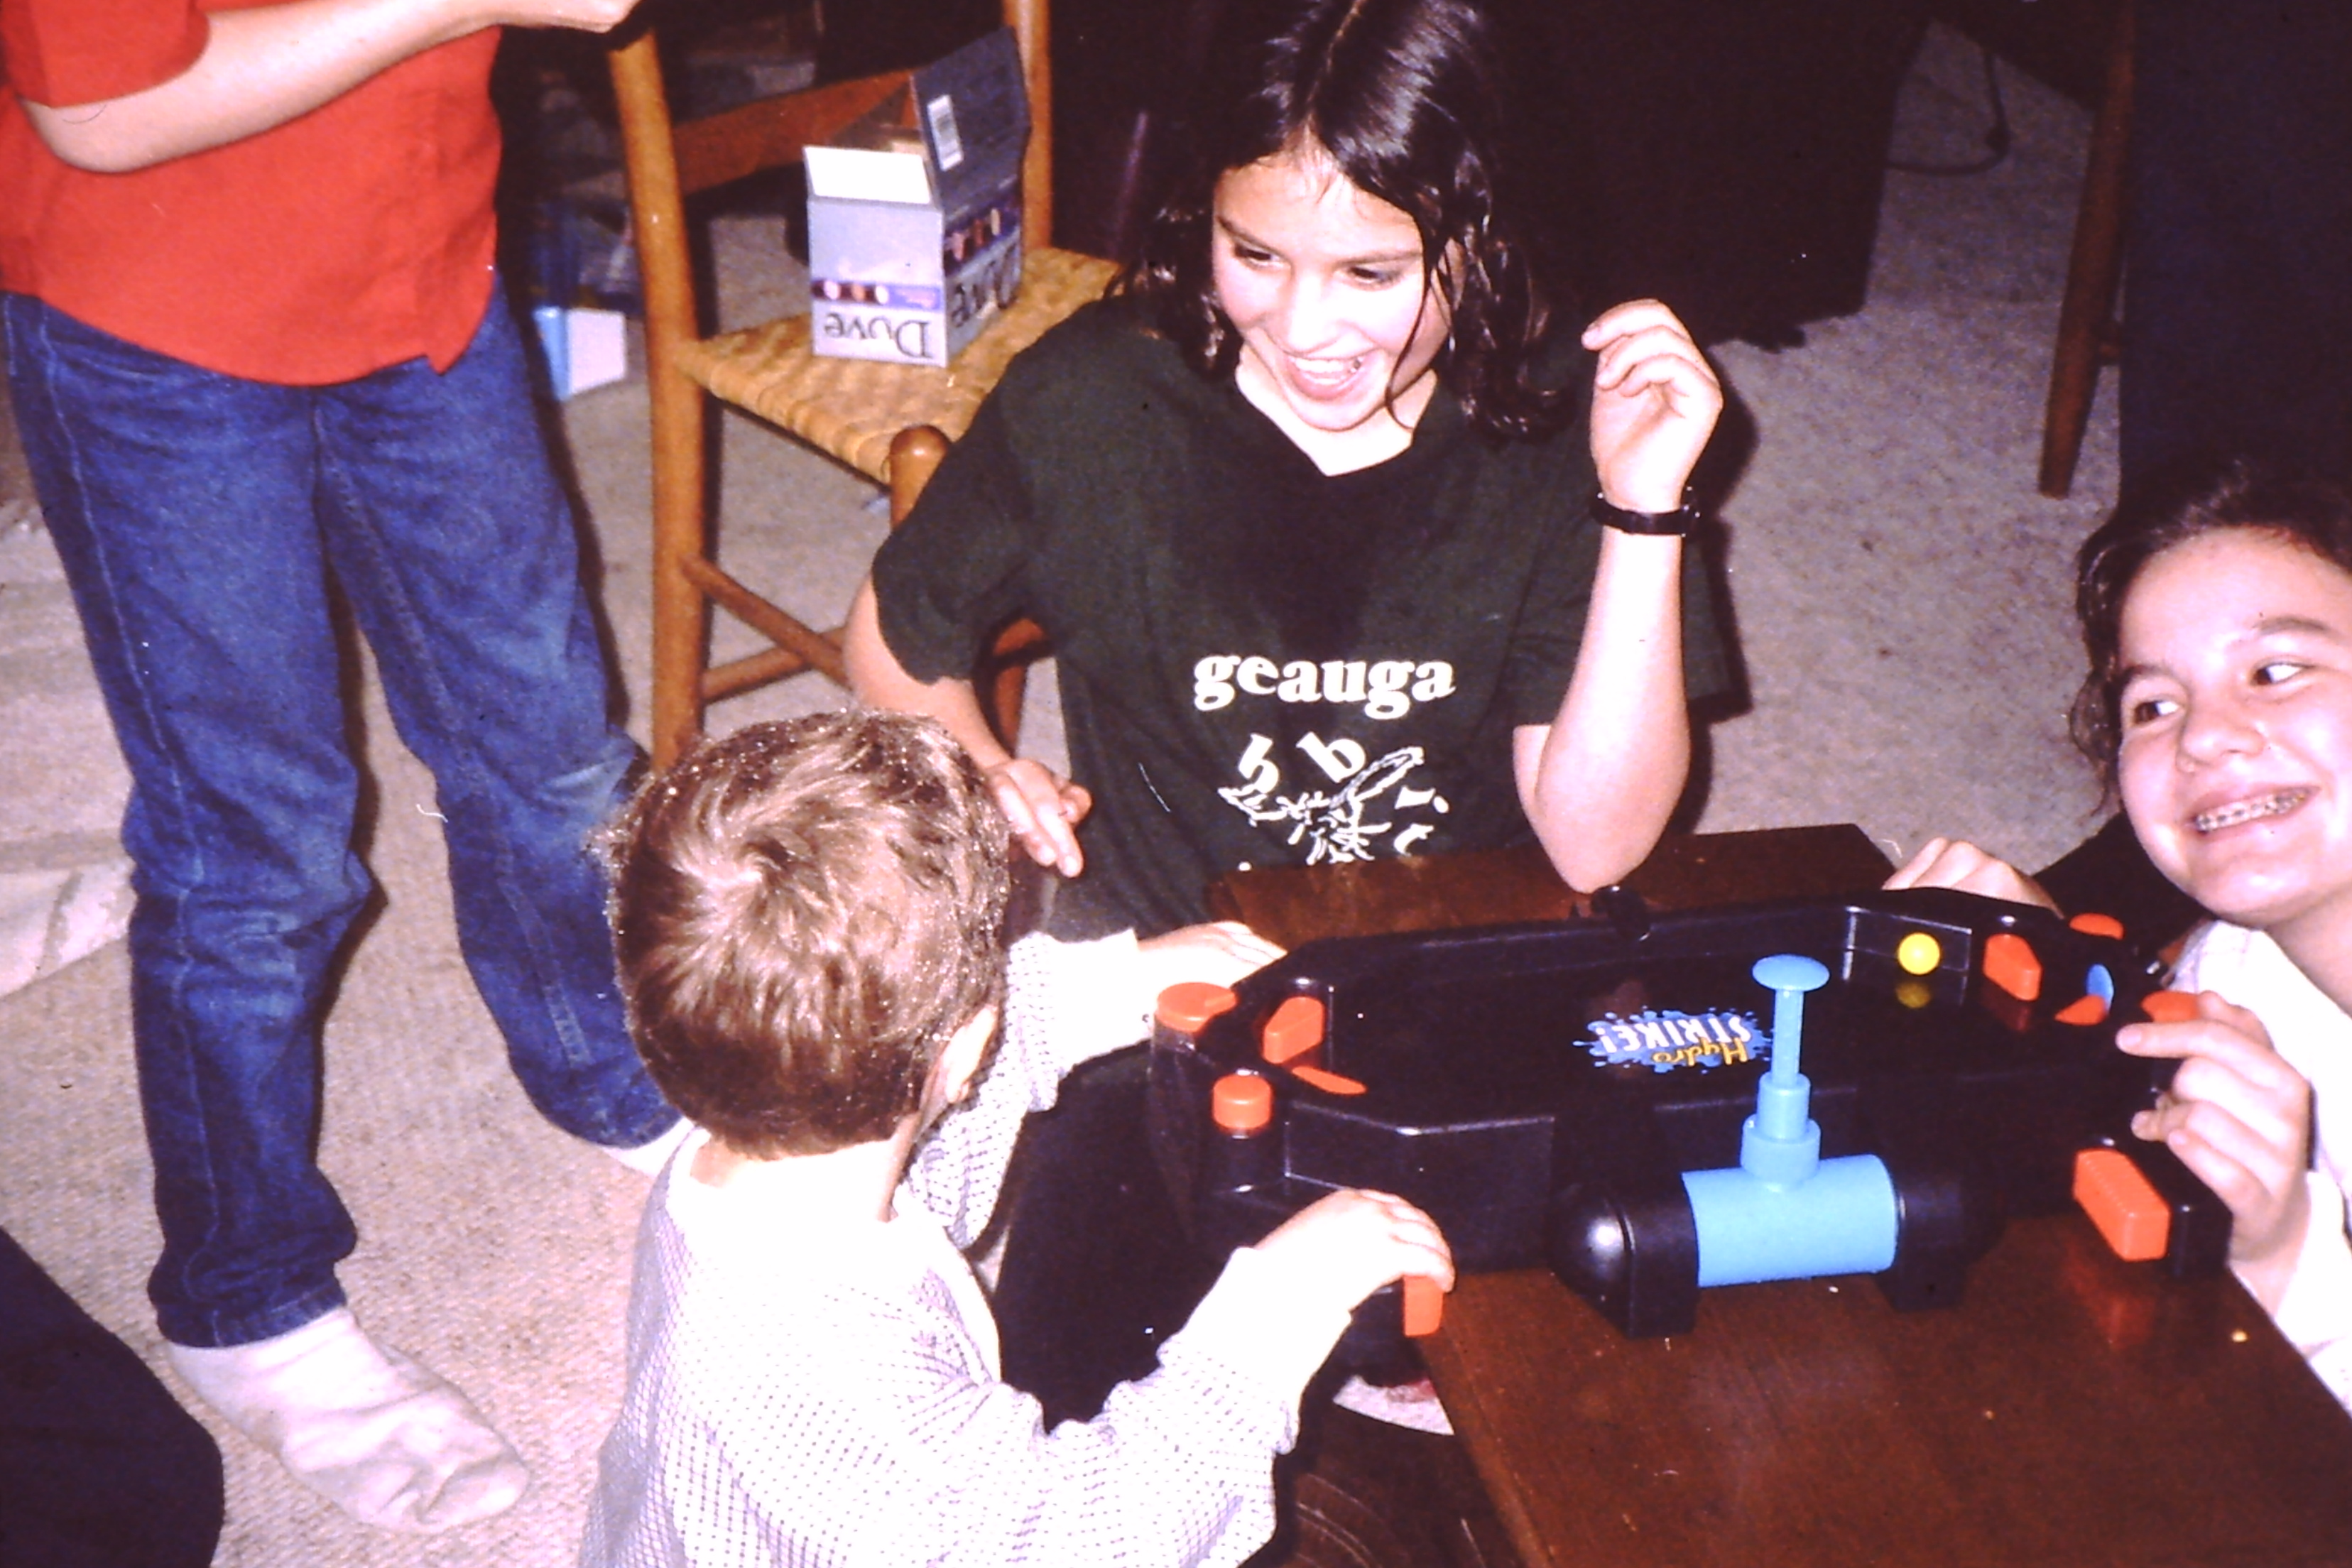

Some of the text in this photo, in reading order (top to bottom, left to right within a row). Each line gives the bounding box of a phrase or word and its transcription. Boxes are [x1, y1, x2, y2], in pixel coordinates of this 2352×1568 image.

[1194, 655, 1457, 720] geauga
[1594, 1016, 1752, 1054] STRIKE!
[1651, 1036, 1749, 1067] Hydro
